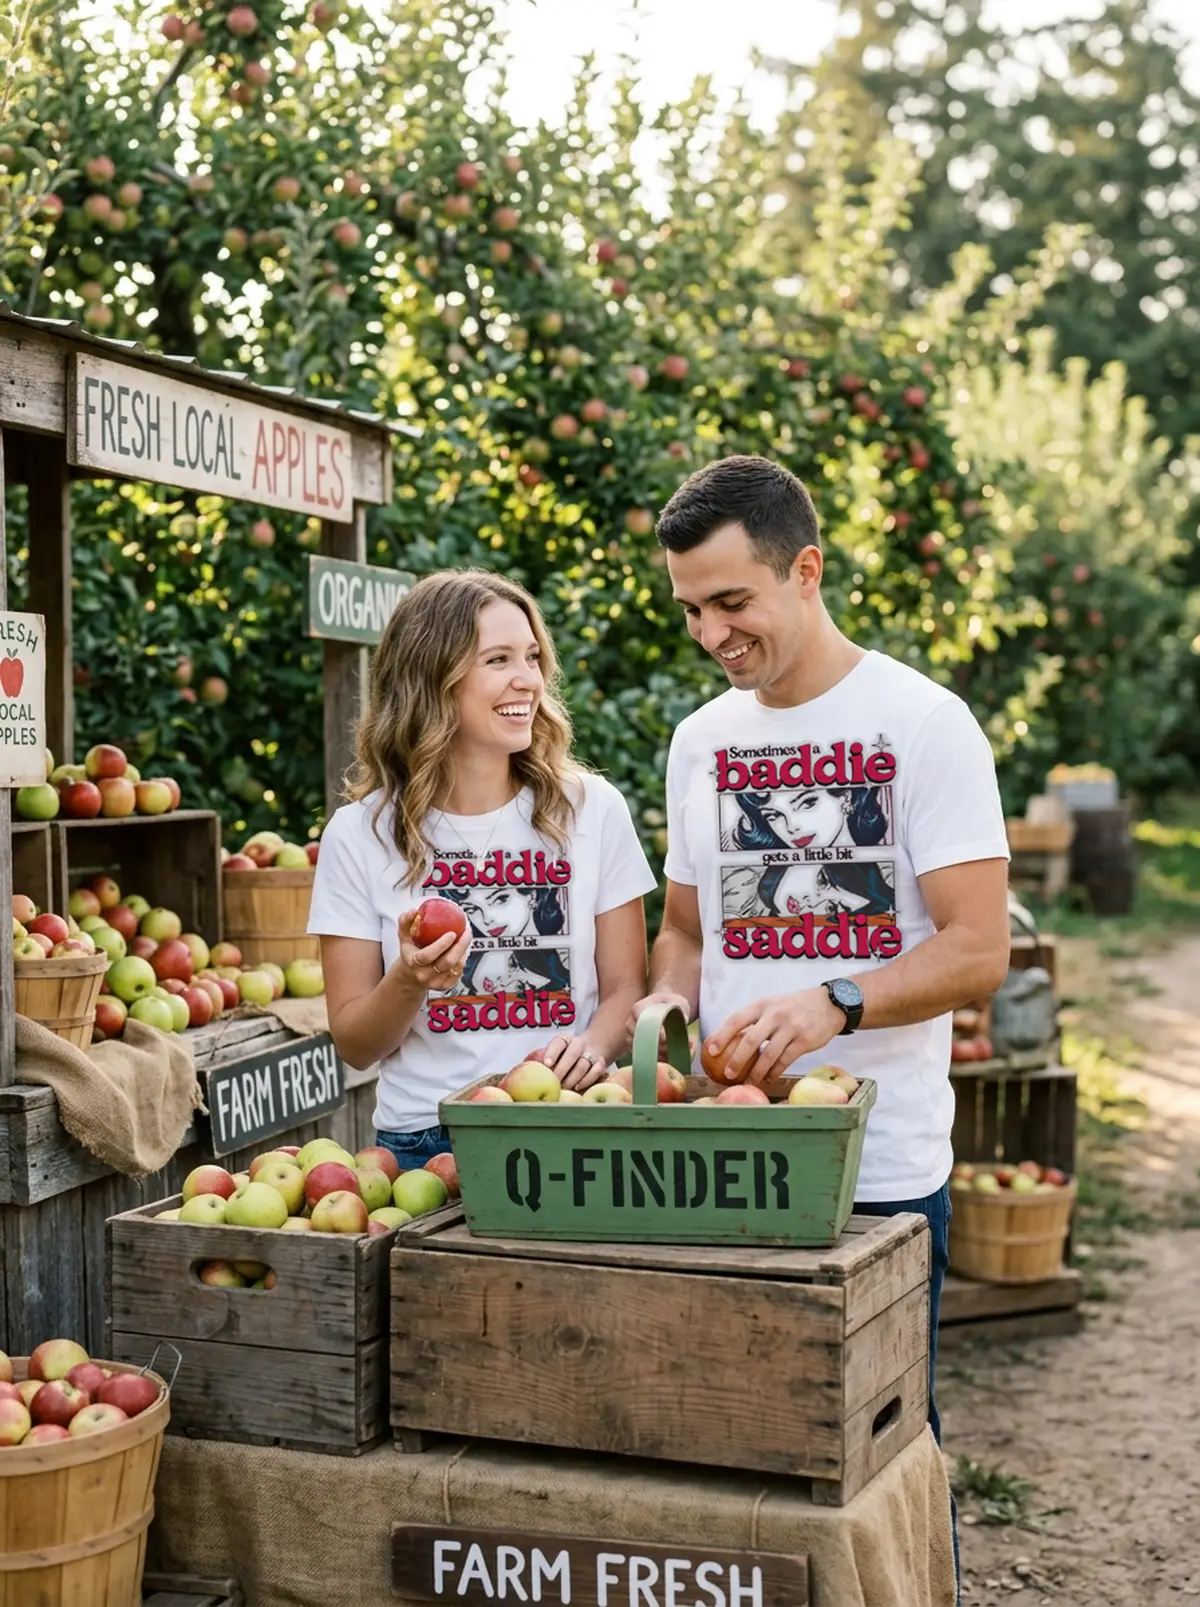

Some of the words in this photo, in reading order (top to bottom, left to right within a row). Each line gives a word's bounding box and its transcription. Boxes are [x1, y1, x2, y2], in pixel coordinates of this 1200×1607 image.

[84, 377, 161, 462] FRESH
[173, 402, 241, 481] LOCAL
[252, 419, 345, 510] APPLES
[0, 620, 38, 653] RESH
[0, 703, 36, 721] OCAL
[0, 727, 37, 745] PLES
[729, 745, 797, 759] Sometimes
[812, 745, 821, 754] a
[714, 741, 897, 792] baddie
[422, 849, 571, 888] baddie
[762, 851, 789, 866] gets
[792, 852, 800, 861] a
[804, 847, 832, 861] little
[836, 847, 853, 860] bit
[488, 941, 495, 949] a
[498, 936, 521, 948] little
[524, 936, 538, 947] bit
[723, 912, 903, 960] saddie
[427, 990, 576, 1033] saddie
[216, 1065, 275, 1142] FARM
[278, 1043, 339, 1118] FRESH
[505, 1148, 790, 1212] Q-FINDER
[433, 1540, 571, 1604] FARM
[597, 1552, 763, 1607] FRESH
